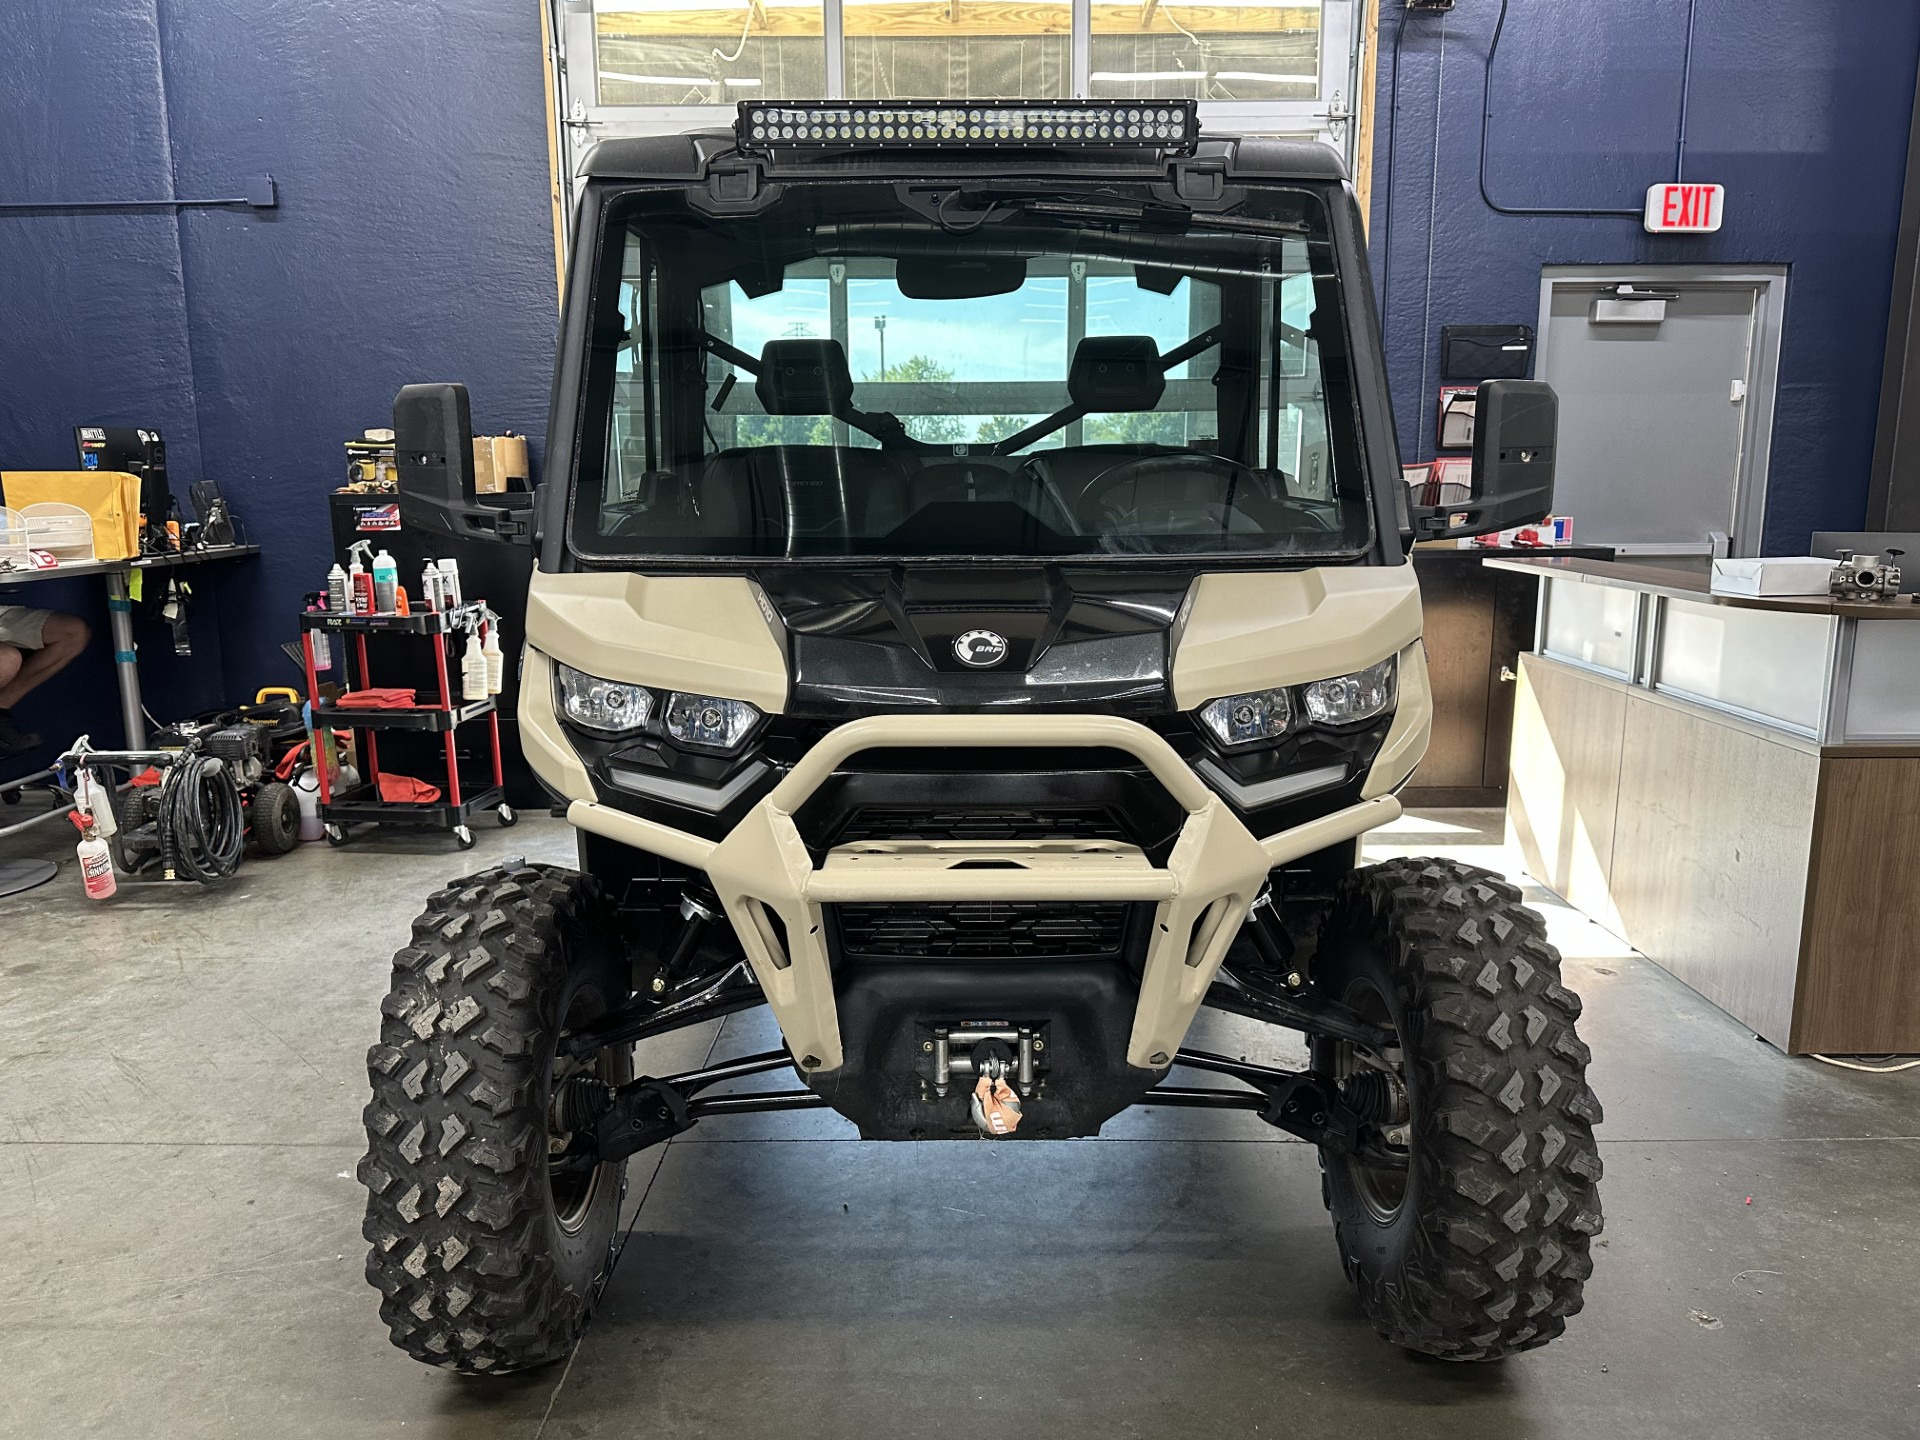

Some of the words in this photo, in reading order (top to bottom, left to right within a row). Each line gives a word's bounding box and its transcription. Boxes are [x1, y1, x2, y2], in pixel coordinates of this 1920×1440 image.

[1662, 186, 1715, 227] EXIT
[758, 591, 774, 624] HD10
[975, 645, 1003, 653] BRP
